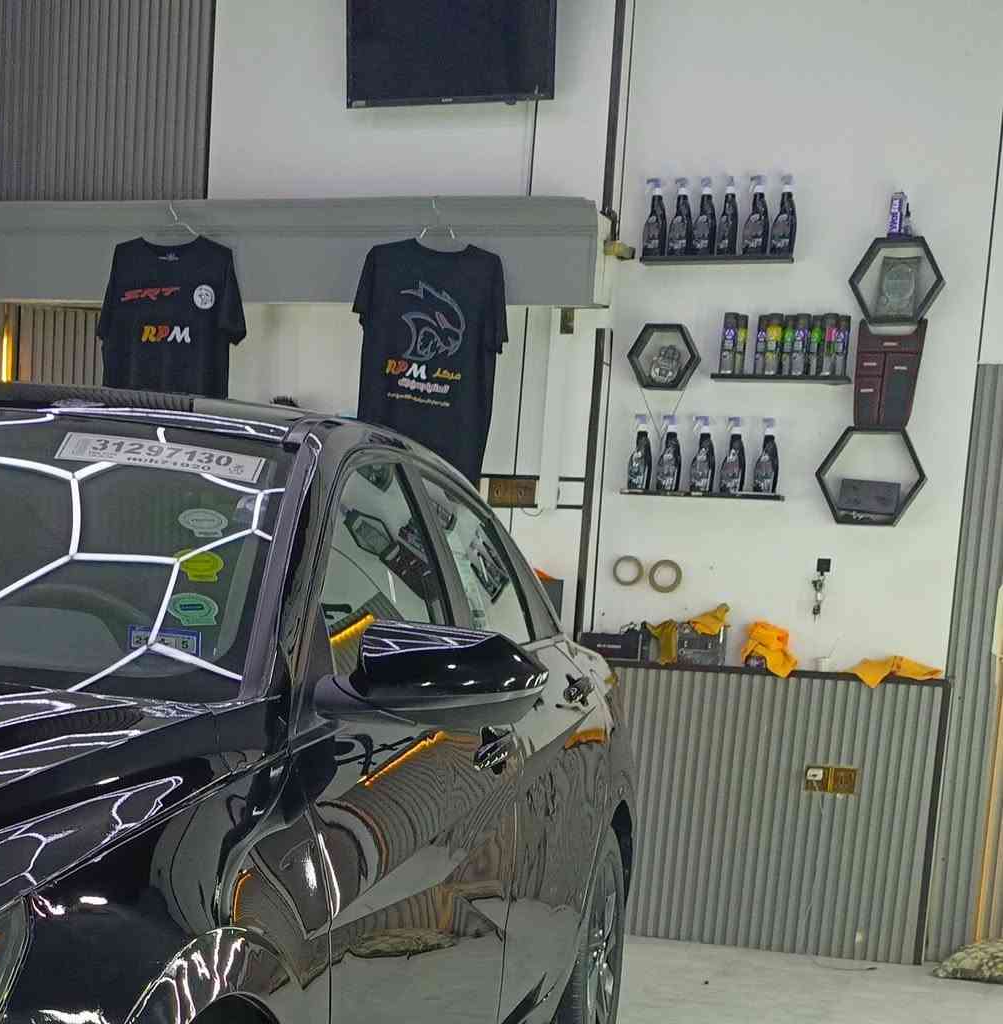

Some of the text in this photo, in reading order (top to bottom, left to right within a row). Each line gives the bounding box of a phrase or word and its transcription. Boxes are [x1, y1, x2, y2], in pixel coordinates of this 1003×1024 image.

[141, 325, 191, 343] RPM
[384, 359, 427, 380] RPM
[91, 438, 233, 467] 31297130
